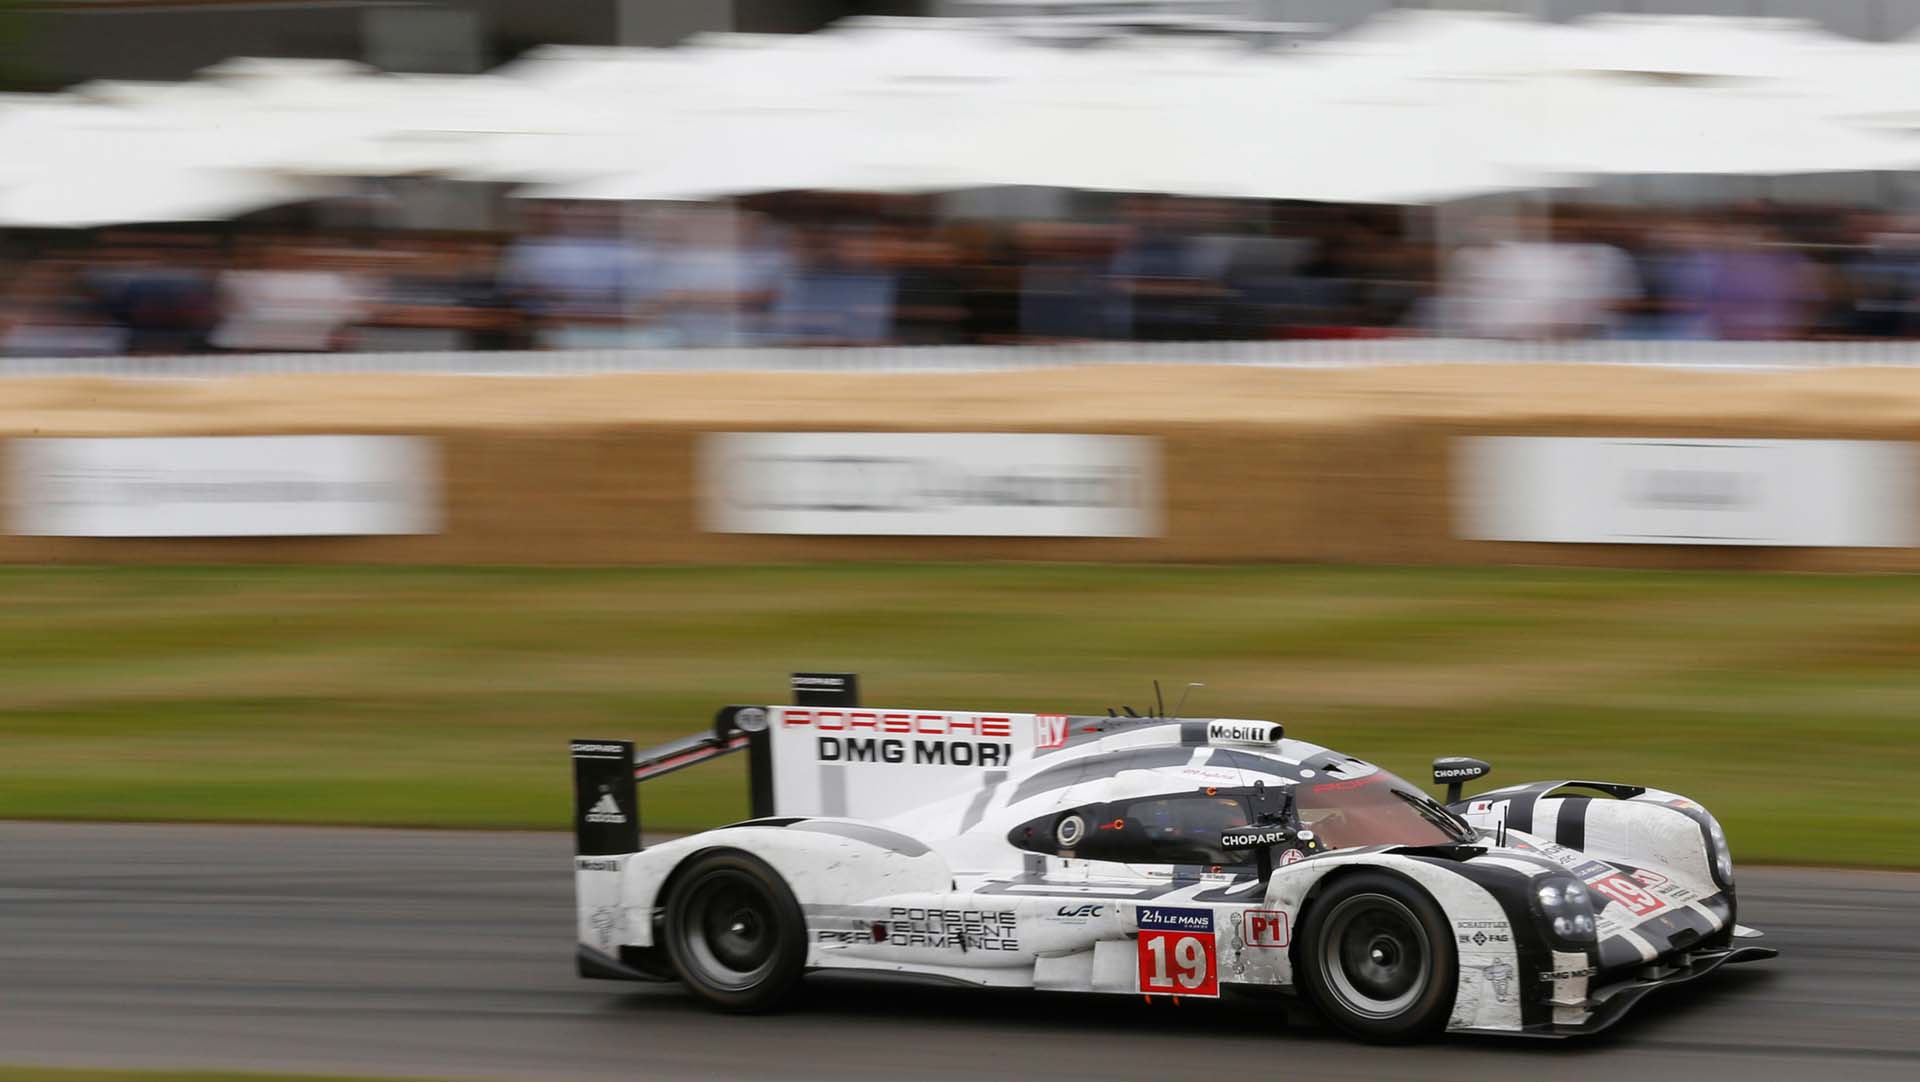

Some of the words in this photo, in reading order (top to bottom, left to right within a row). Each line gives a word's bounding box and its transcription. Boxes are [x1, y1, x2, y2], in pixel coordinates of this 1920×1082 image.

[783, 710, 1011, 738] PORSCHE
[1210, 725, 1250, 741] Mobil
[818, 737, 904, 764] DMG
[1434, 767, 1482, 778] CHOPARD
[891, 907, 1016, 926] PORSCHE
[1057, 904, 1104, 918] WEC
[1164, 916, 1177, 924] LE
[1178, 917, 1209, 926] MANS
[1252, 917, 1281, 942] P1
[817, 930, 1020, 951] PERORMANCE
[1147, 935, 1207, 990] 19
